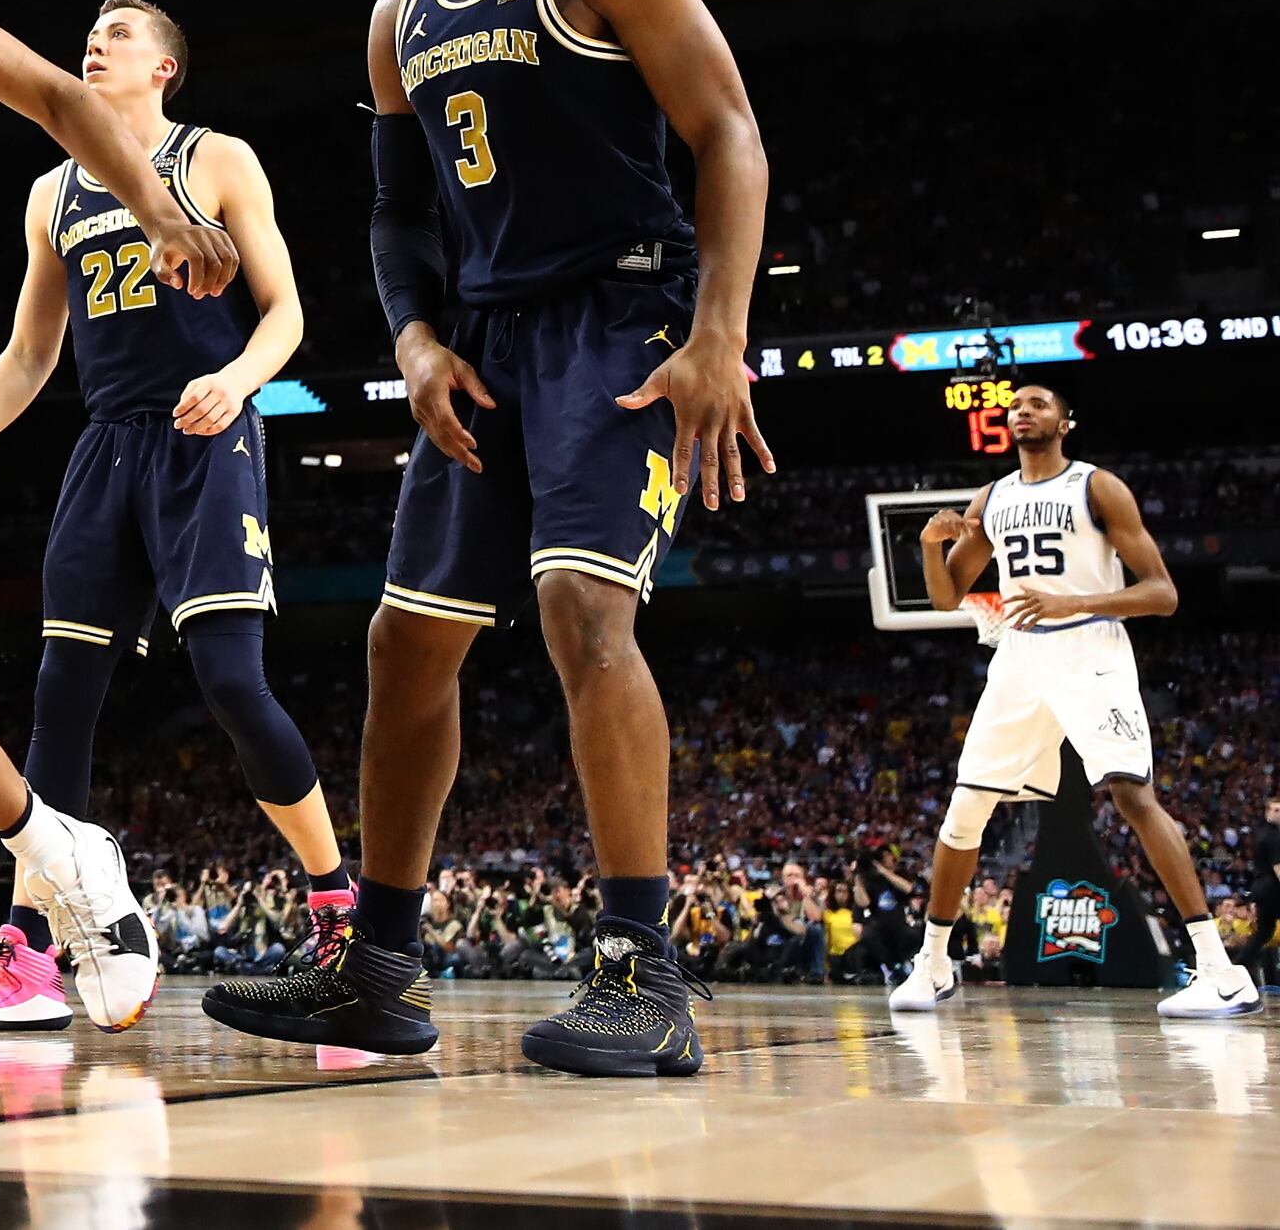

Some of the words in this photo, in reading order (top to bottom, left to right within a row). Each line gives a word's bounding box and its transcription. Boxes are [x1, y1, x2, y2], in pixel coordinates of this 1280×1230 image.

[399, 27, 540, 102] MICHIGAN
[444, 89, 497, 190] 3
[59, 207, 140, 257] MICHIG
[81, 241, 157, 319] 22
[1106, 318, 1207, 350] 10:36
[1220, 317, 1268, 340] 2ND
[797, 350, 815, 370] 4
[831, 347, 863, 367] TOL
[867, 346, 884, 366] 2
[364, 380, 408, 402] THE
[945, 380, 1016, 410] 10:36
[968, 408, 1011, 453] 15
[639, 449, 683, 538] M
[991, 501, 1076, 537] VILLANOVA
[1004, 532, 1066, 578] 25
[1040, 895, 1099, 919] FINAL
[1046, 914, 1102, 936] FOUR
